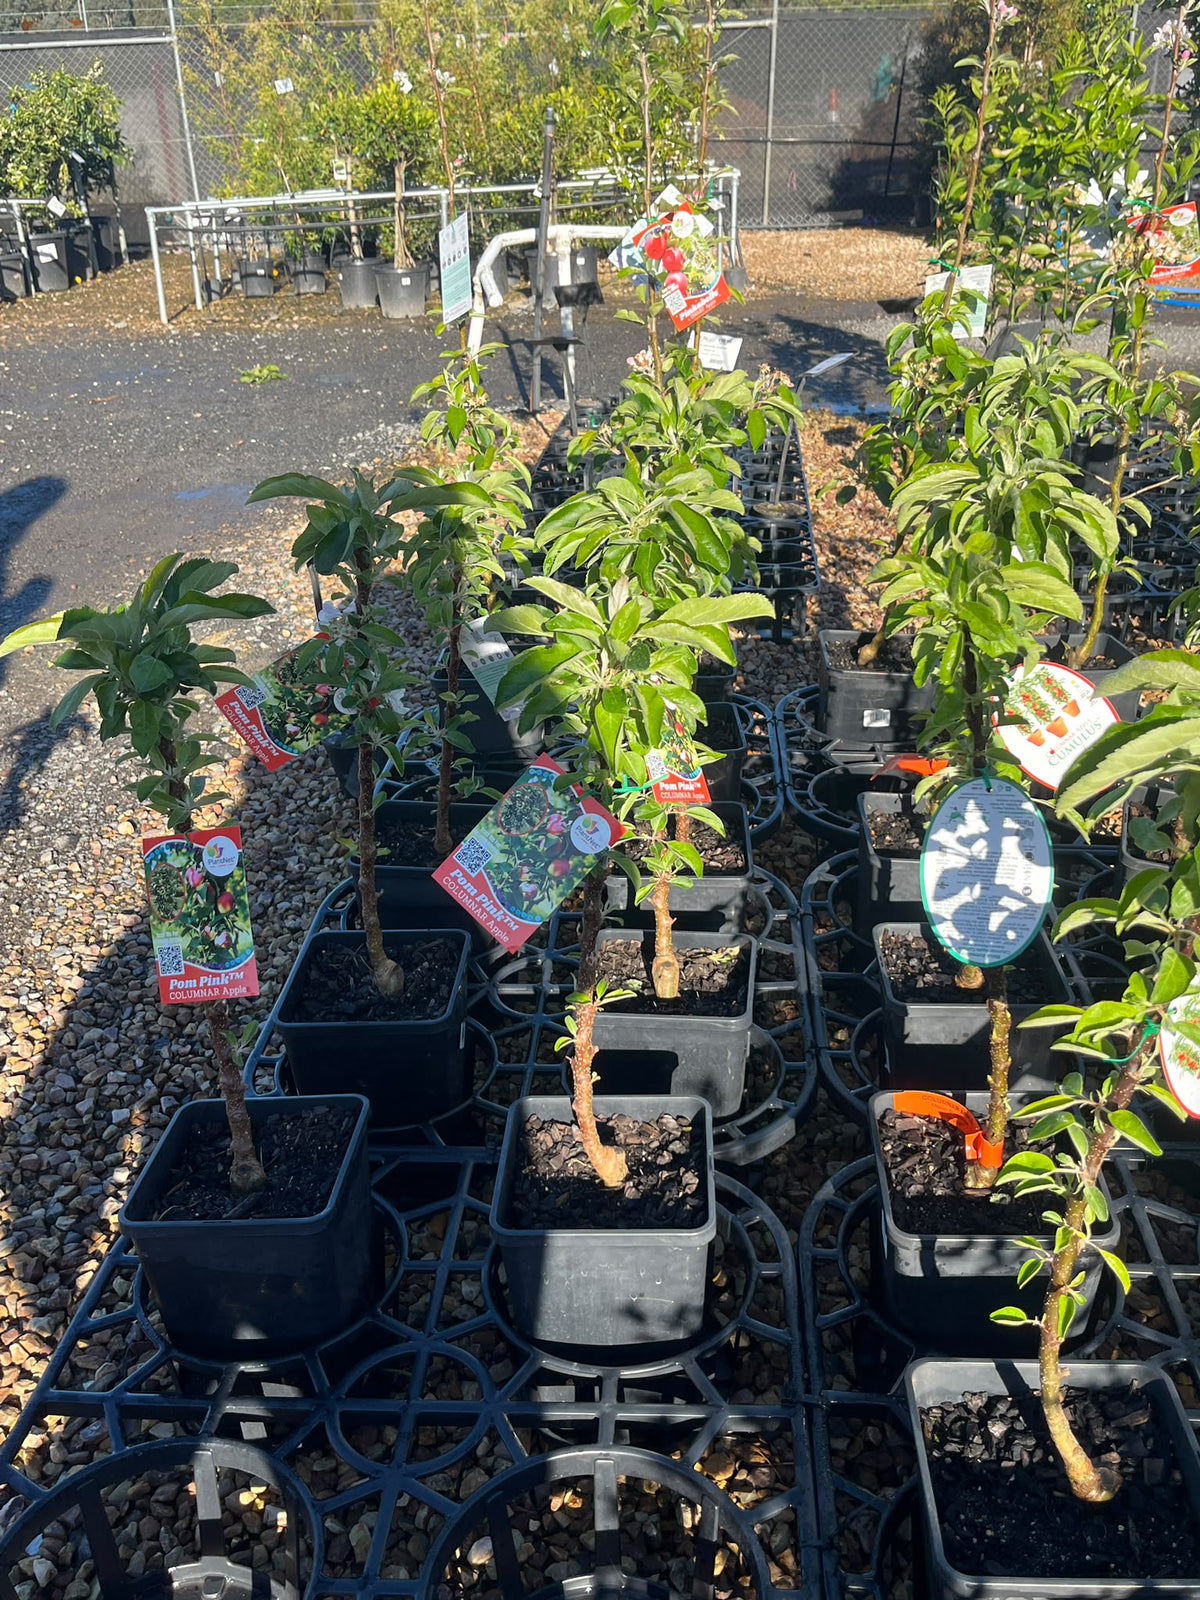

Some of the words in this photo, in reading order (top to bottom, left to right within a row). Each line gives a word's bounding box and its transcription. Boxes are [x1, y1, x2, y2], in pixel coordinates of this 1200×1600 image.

[229, 701, 250, 724] Pom
[222, 704, 254, 745] COLUMNAR
[253, 745, 270, 763] Apple
[1048, 720, 1102, 767] CUMULUS
[659, 781, 677, 791] Pom
[450, 868, 477, 896] Pom
[442, 876, 487, 922] COLUMNAR
[487, 918, 509, 943] Apple
[169, 978, 197, 989] Pom
[169, 988, 220, 1000] COLUMNAR
[223, 985, 247, 997] Apple
